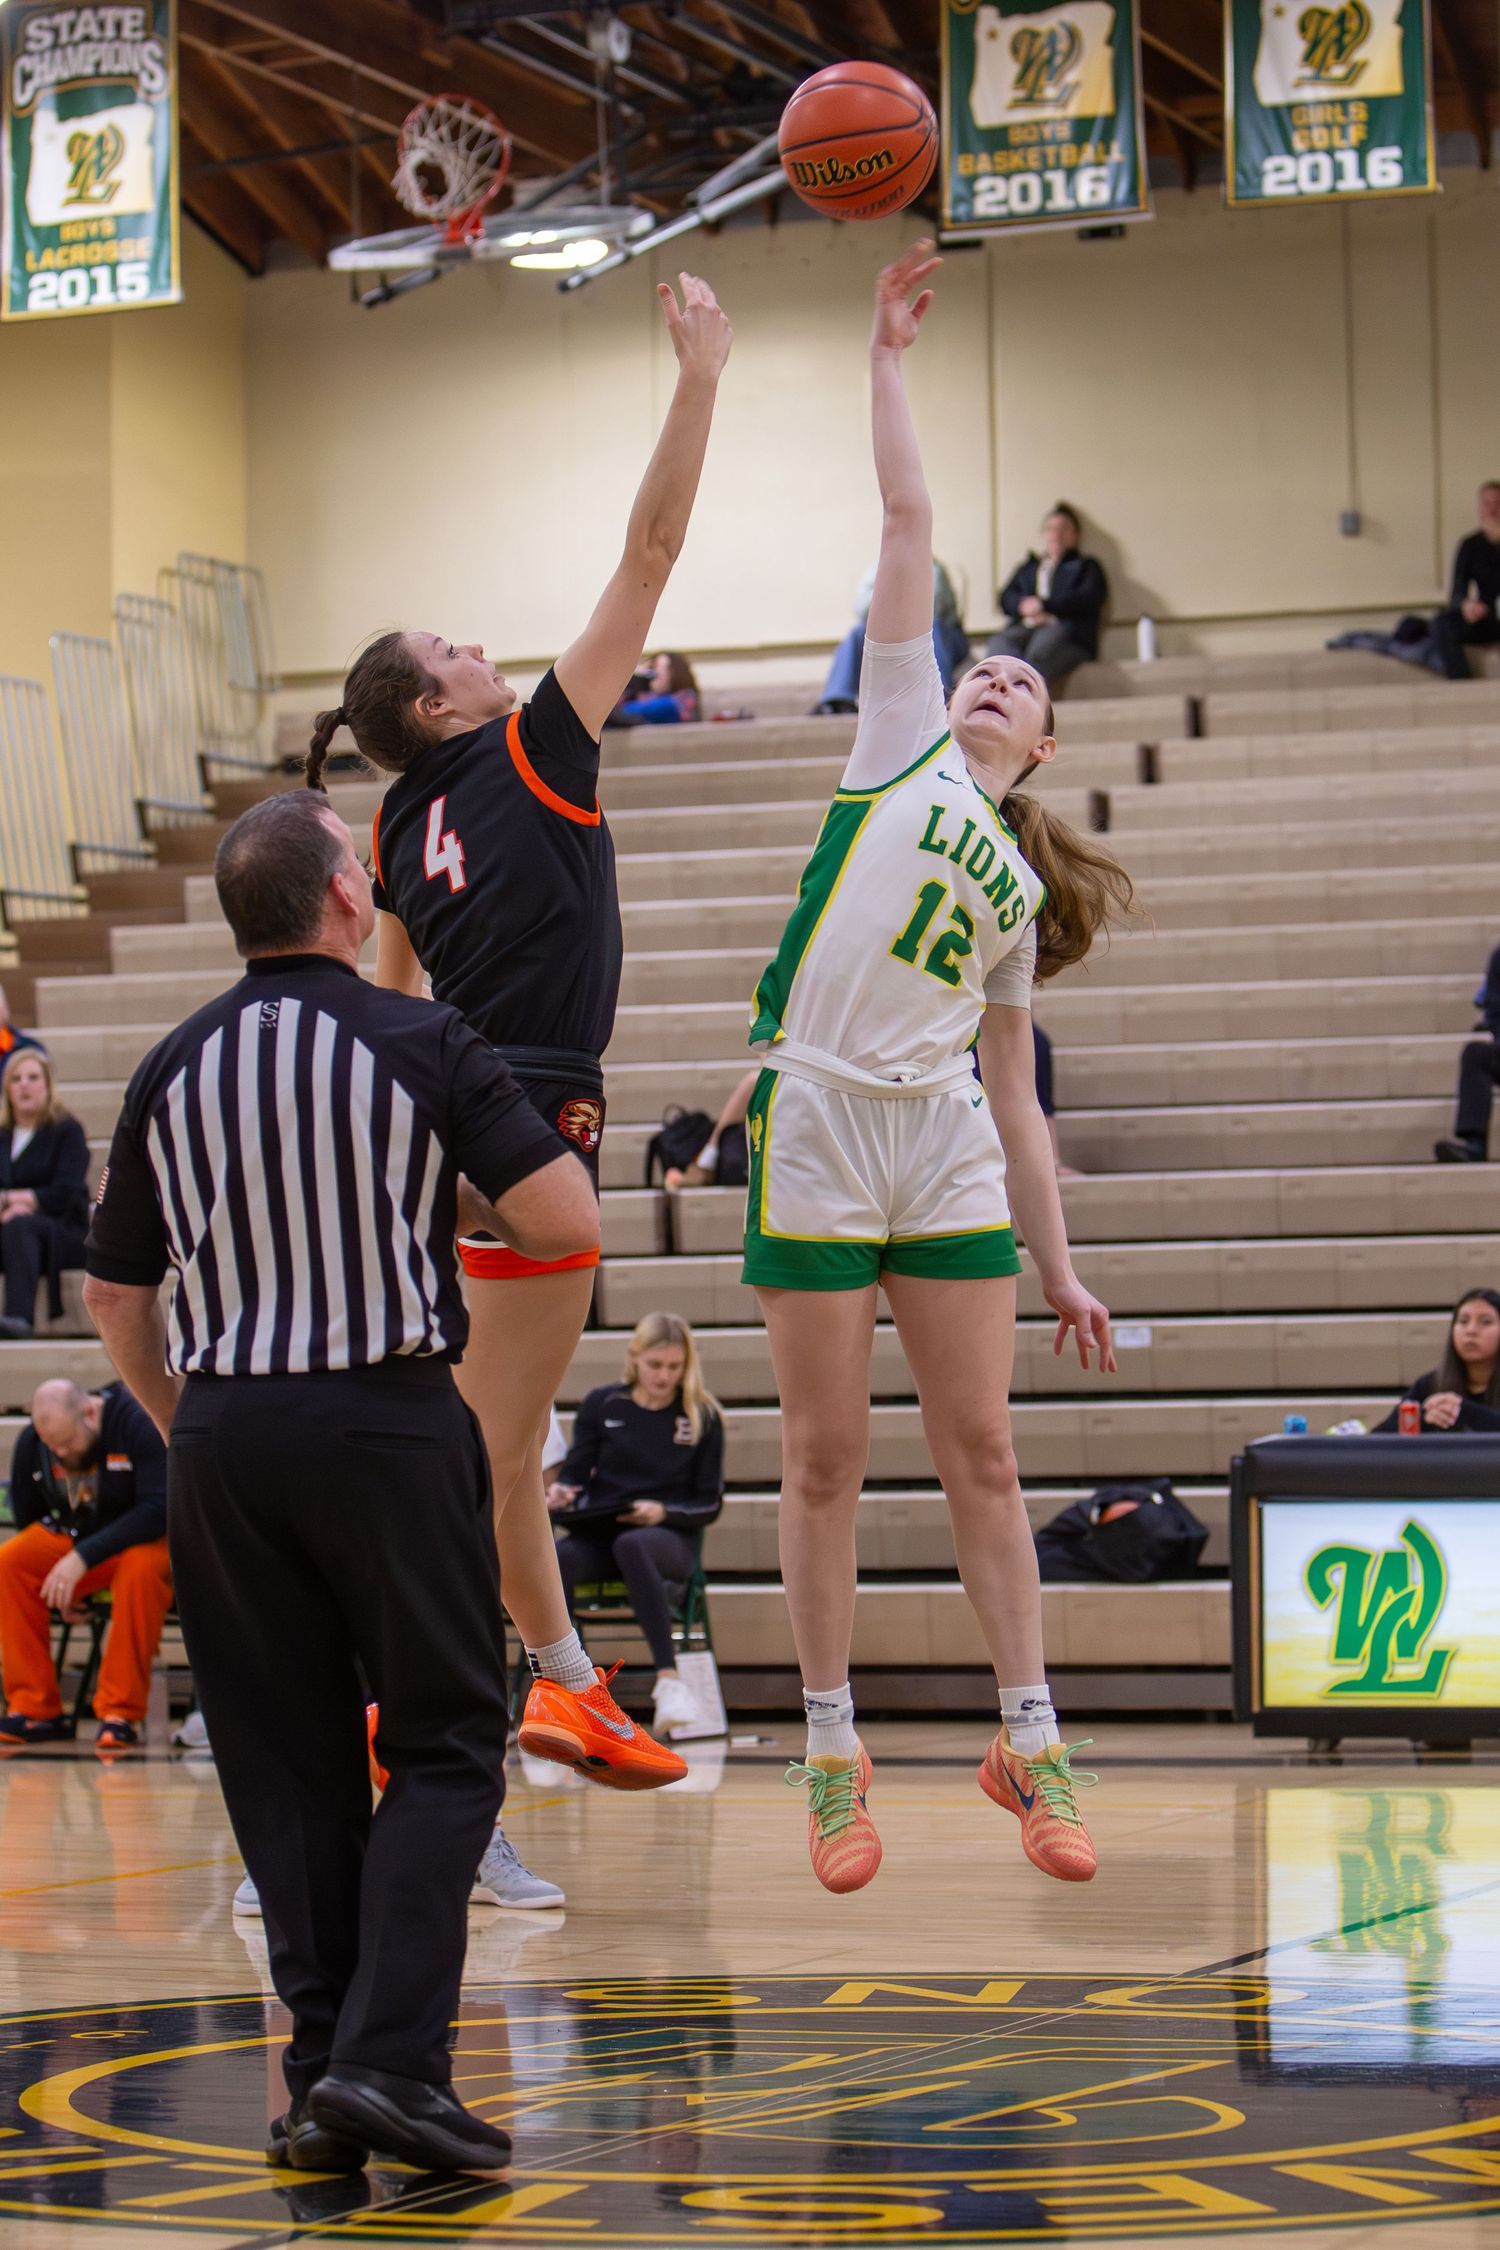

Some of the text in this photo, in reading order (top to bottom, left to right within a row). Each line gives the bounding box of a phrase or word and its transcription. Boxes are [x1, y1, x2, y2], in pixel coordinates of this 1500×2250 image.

[25, 6, 145, 50] STATE
[13, 38, 167, 108] CHAMPIONS
[1007, 121, 1072, 146] BOYS
[1291, 101, 1368, 126] GIRLS
[958, 141, 1125, 176] BASKETBALL
[1291, 124, 1367, 152] GOLF
[791, 149, 894, 188] Wilson
[1261, 145, 1403, 196] 2016
[973, 166, 1110, 220] 2016
[60, 217, 117, 241] BOYS
[25, 237, 150, 272] LACROSSE
[28, 262, 149, 312] 2015
[424, 794, 467, 894] 4
[917, 804, 1026, 933] LIONS
[887, 877, 975, 990] 12
